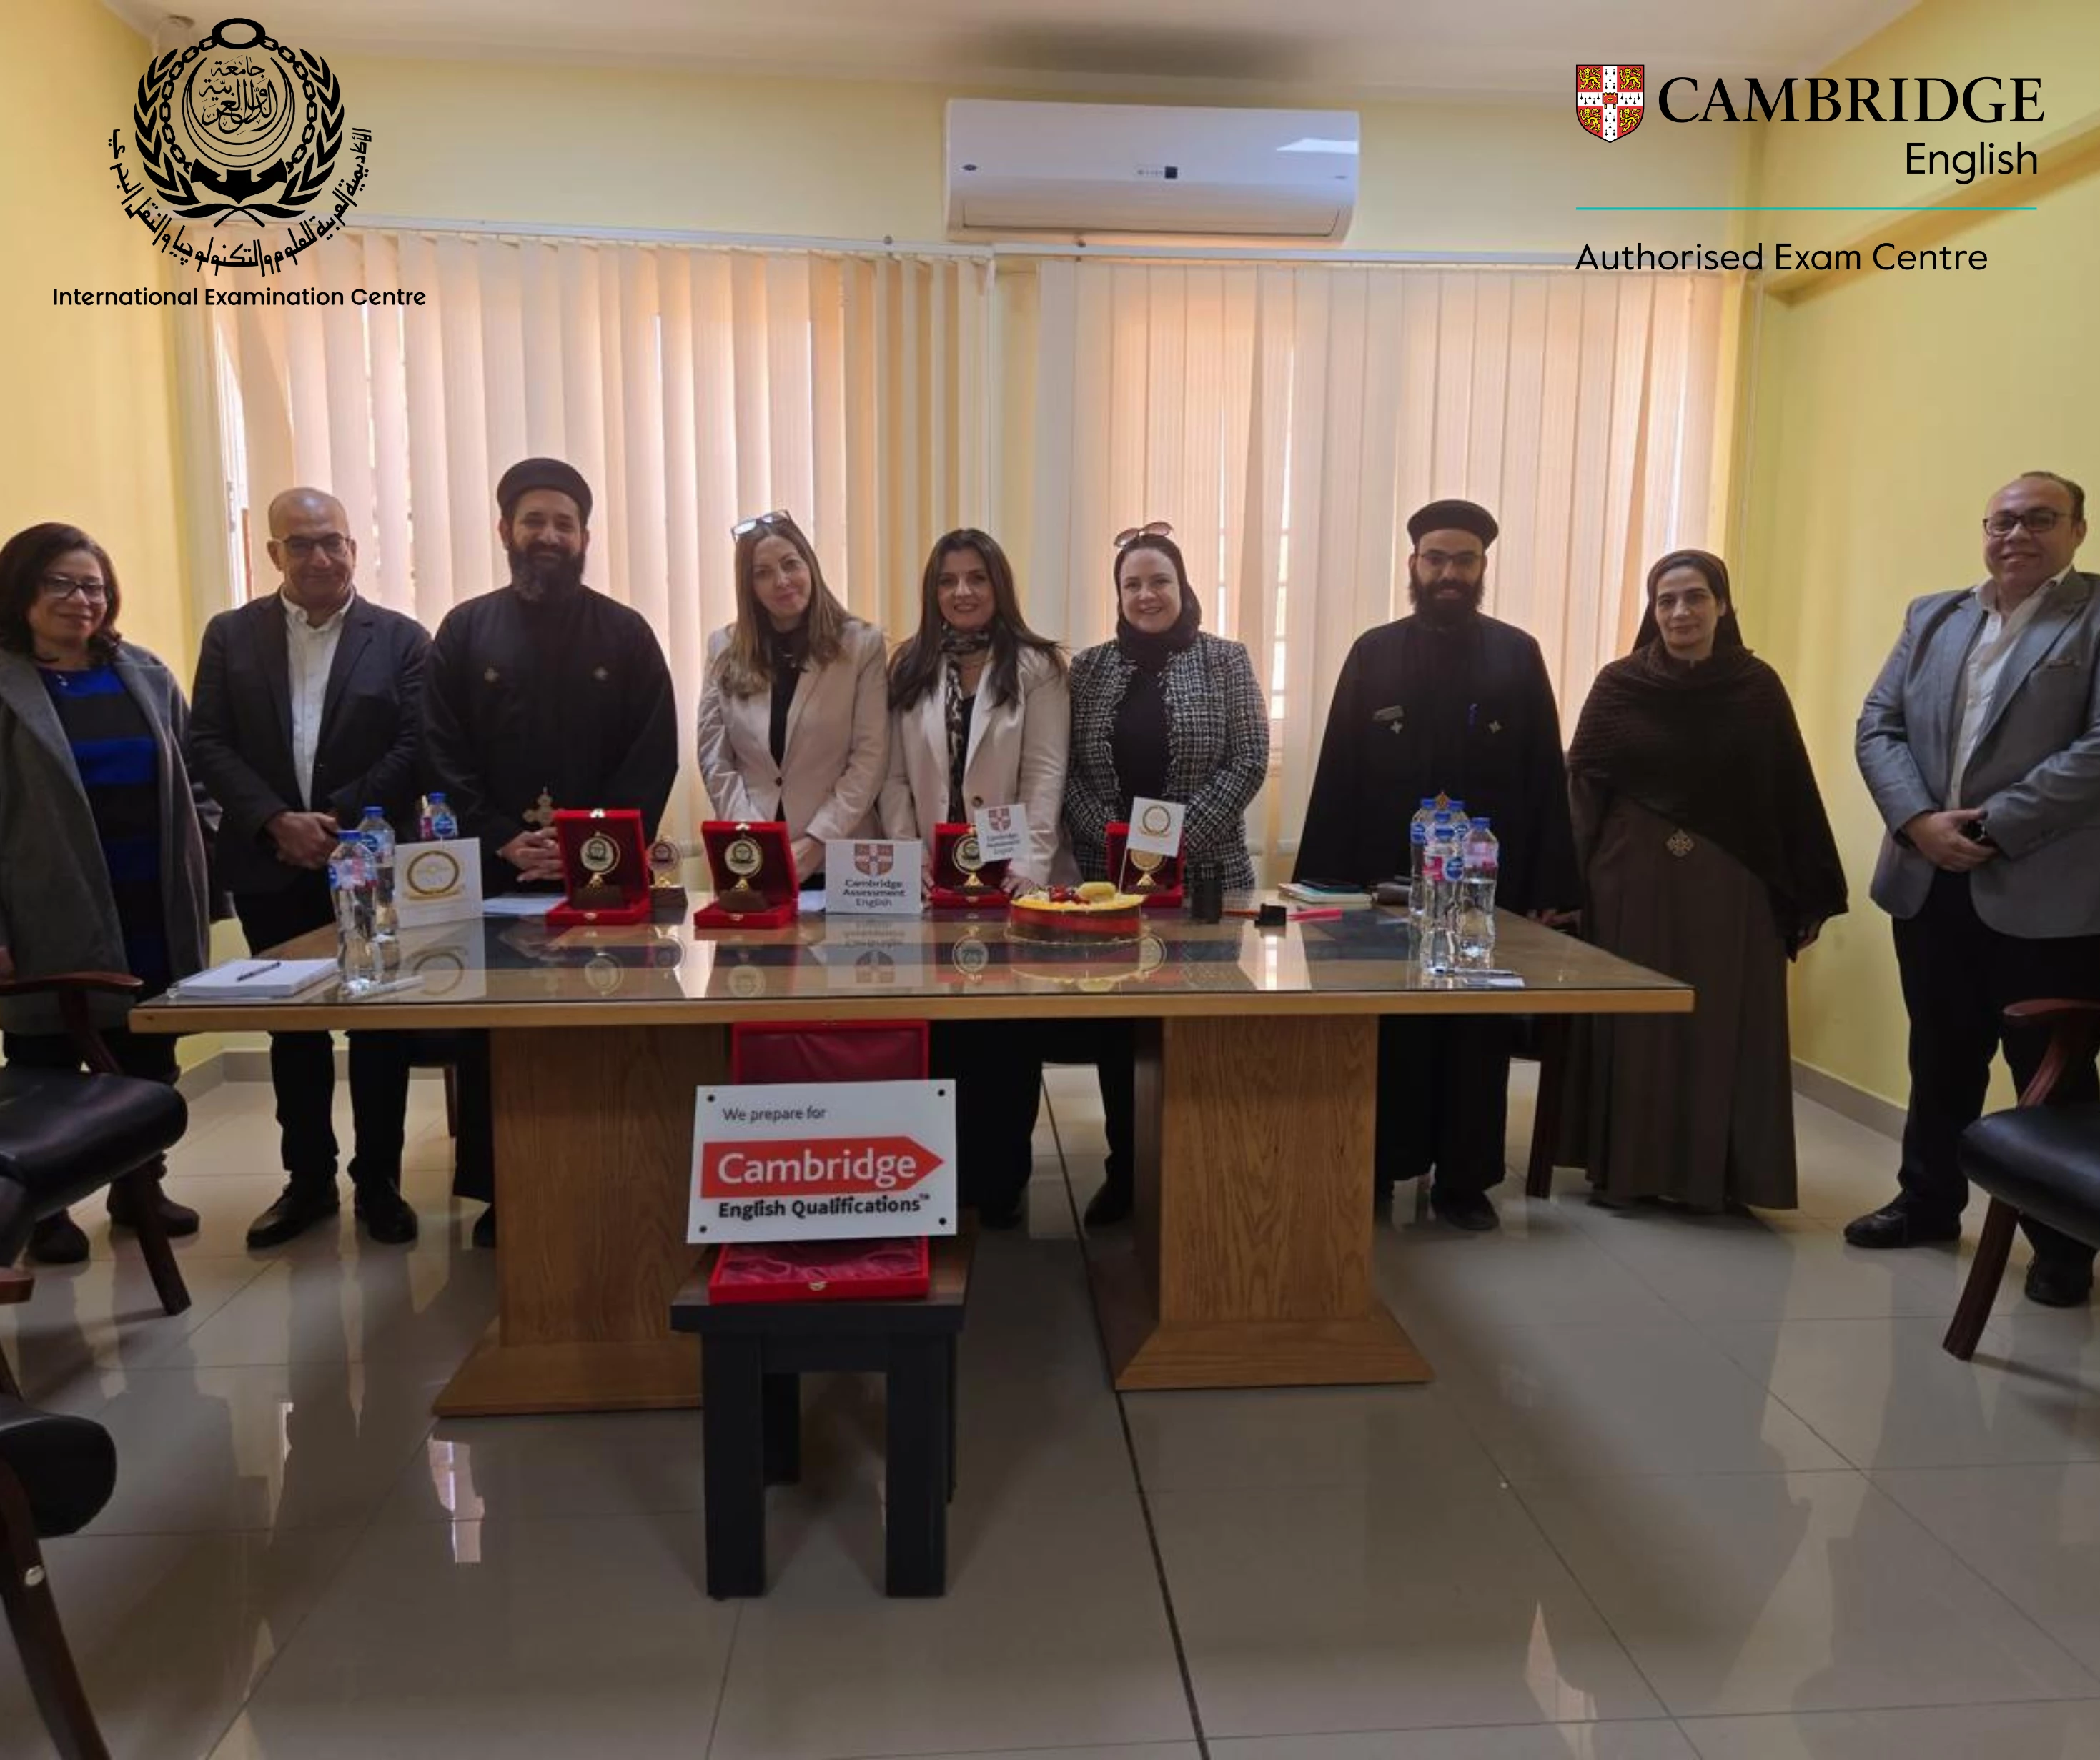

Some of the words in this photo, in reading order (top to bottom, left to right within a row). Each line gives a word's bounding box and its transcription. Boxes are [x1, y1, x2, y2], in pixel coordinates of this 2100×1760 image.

[845, 880, 903, 888] Cambridge
[722, 1108, 747, 1121] We
[750, 1108, 804, 1124] prepare
[806, 1105, 826, 1120] for
[718, 1148, 917, 1188] Cambridge
[718, 1199, 786, 1221] English
